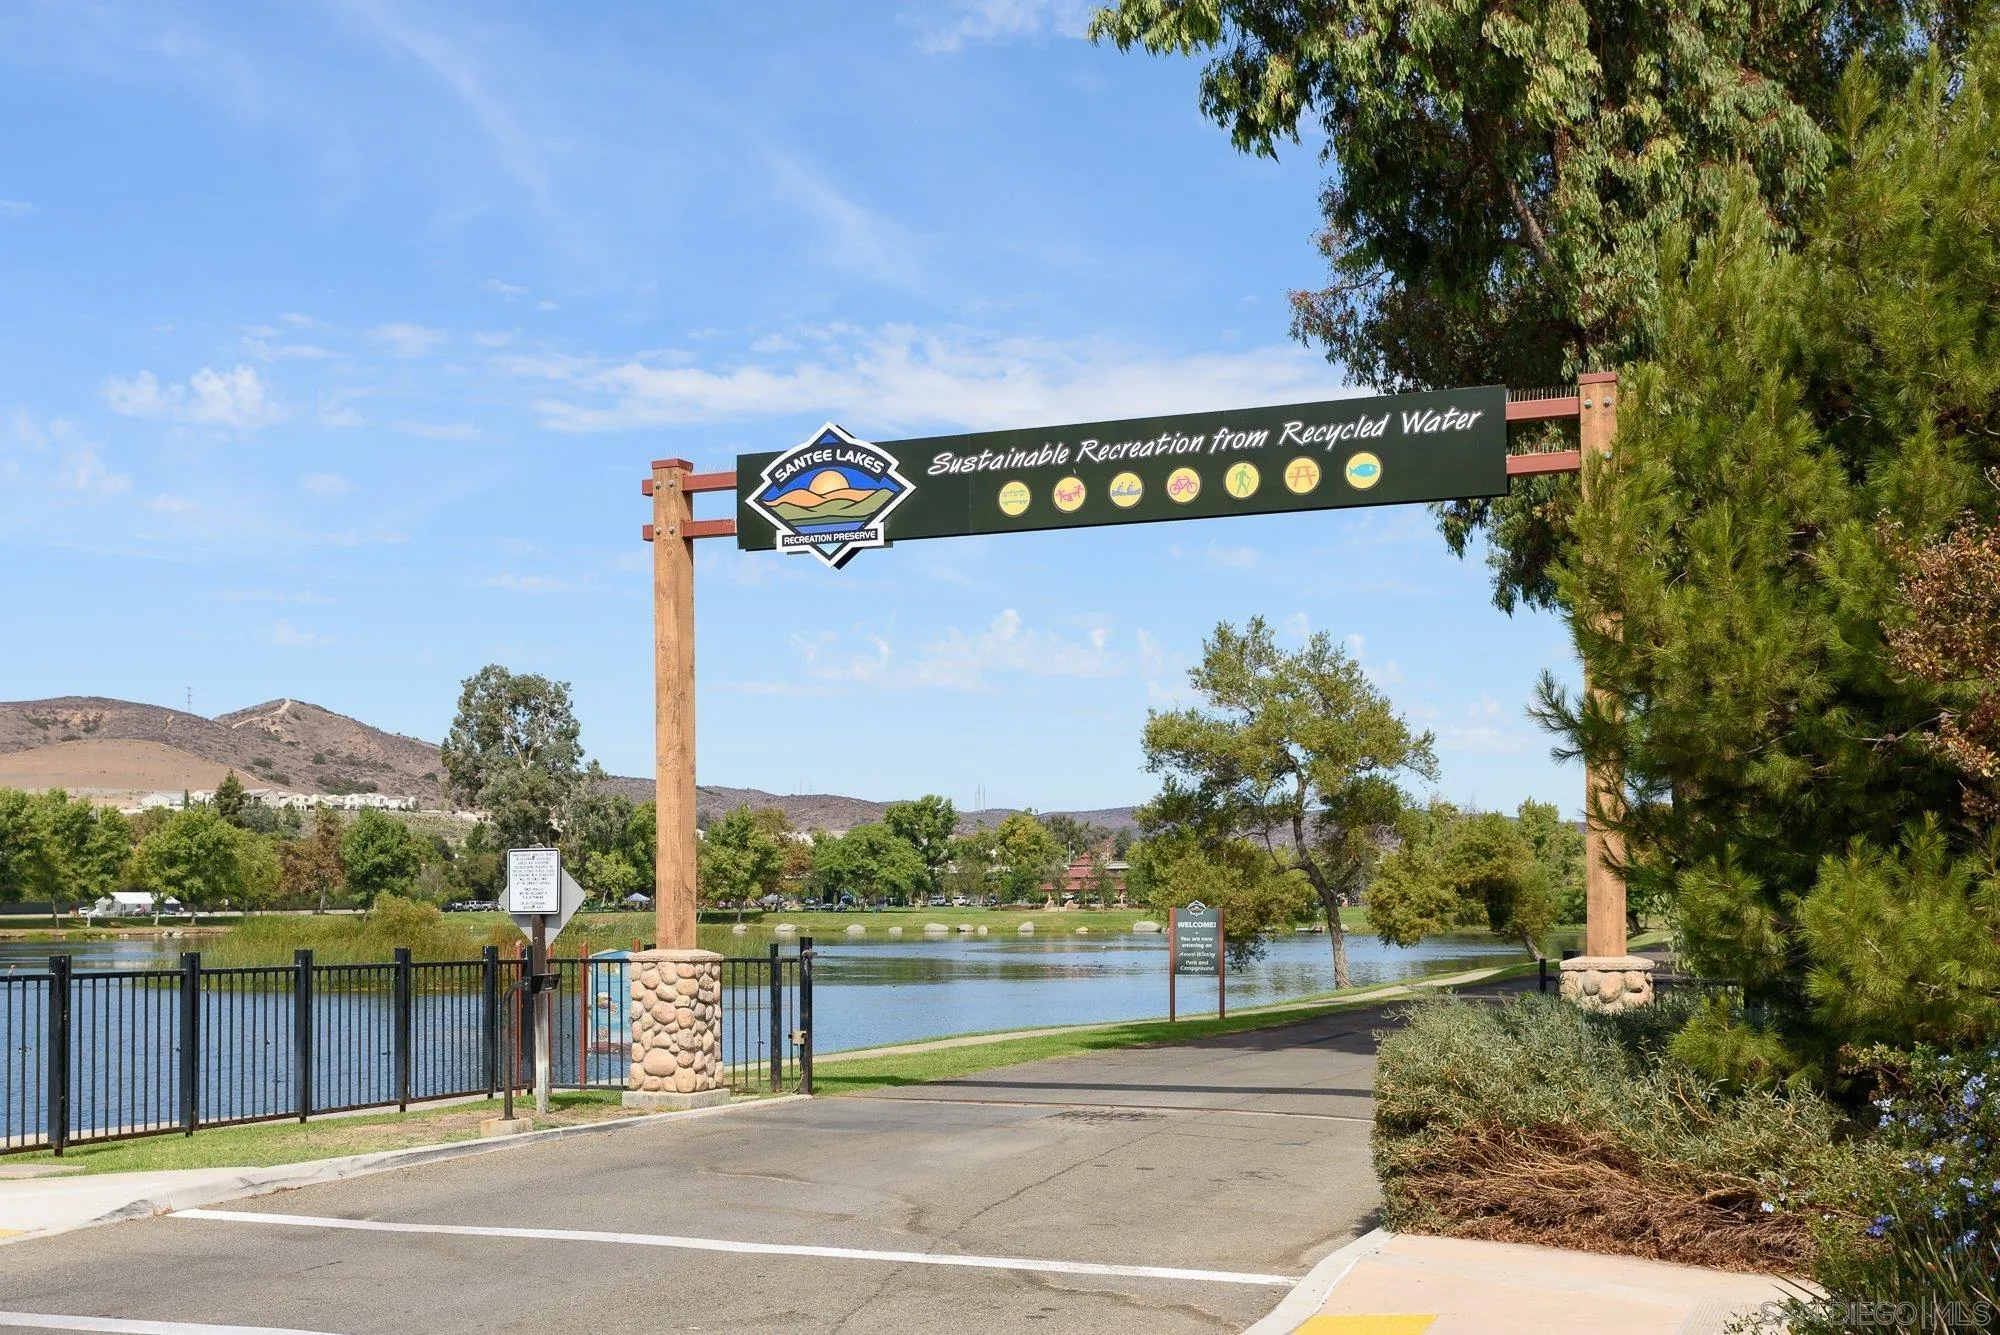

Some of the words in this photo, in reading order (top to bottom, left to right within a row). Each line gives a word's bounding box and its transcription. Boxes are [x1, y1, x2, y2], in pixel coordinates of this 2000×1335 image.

[927, 442, 1070, 476] Sustainable
[1075, 433, 1205, 464] Recreation
[1209, 426, 1269, 455] from
[1277, 412, 1391, 451] Recycled
[1401, 407, 1482, 435] Water
[775, 449, 832, 482] SANTEE
[836, 449, 885, 474] LAKES
[784, 534, 832, 545] RECREATION
[833, 530, 876, 541] PRESERVE
